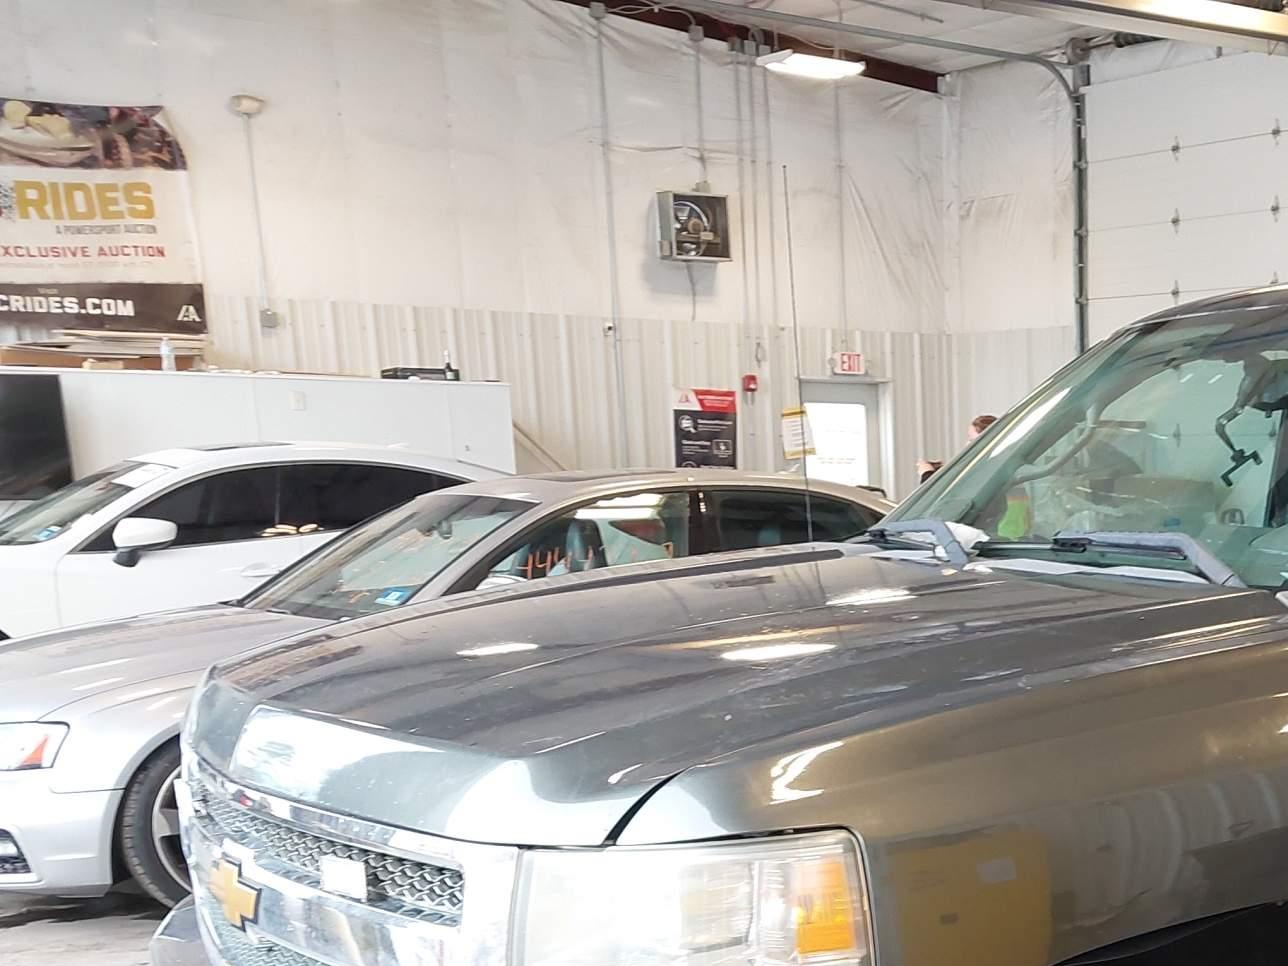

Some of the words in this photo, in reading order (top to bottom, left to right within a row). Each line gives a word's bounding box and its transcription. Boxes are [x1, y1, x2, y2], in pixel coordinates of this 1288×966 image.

[13, 180, 156, 221] RIDES
[0, 245, 92, 258] XCLUSIVE
[97, 245, 167, 258] AUCTION
[840, 353, 861, 372] EXIT
